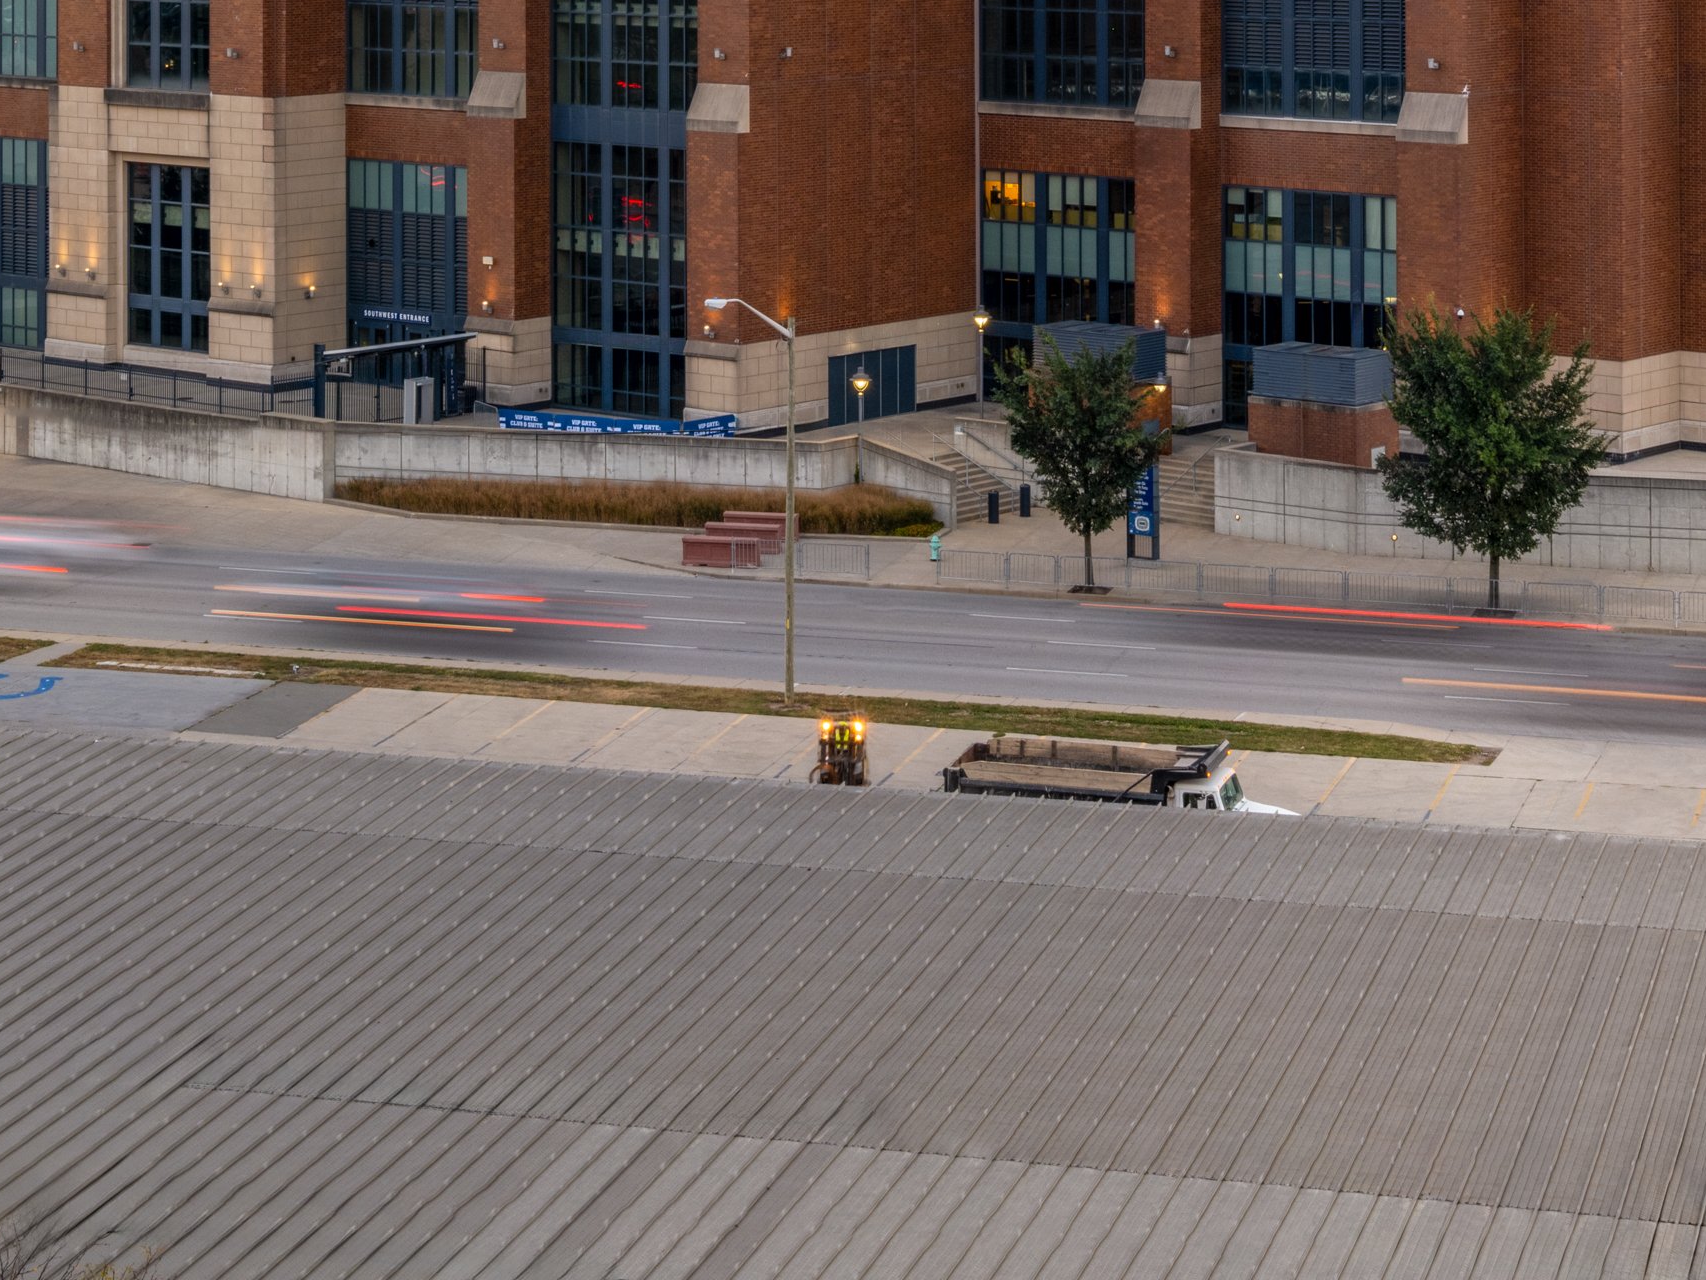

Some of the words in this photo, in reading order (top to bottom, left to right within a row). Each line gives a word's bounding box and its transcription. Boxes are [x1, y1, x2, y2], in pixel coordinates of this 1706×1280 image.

[363, 309, 398, 320] SOUTHWEST
[399, 313, 430, 323] ENTRANCE
[698, 422, 706, 430] VIP
